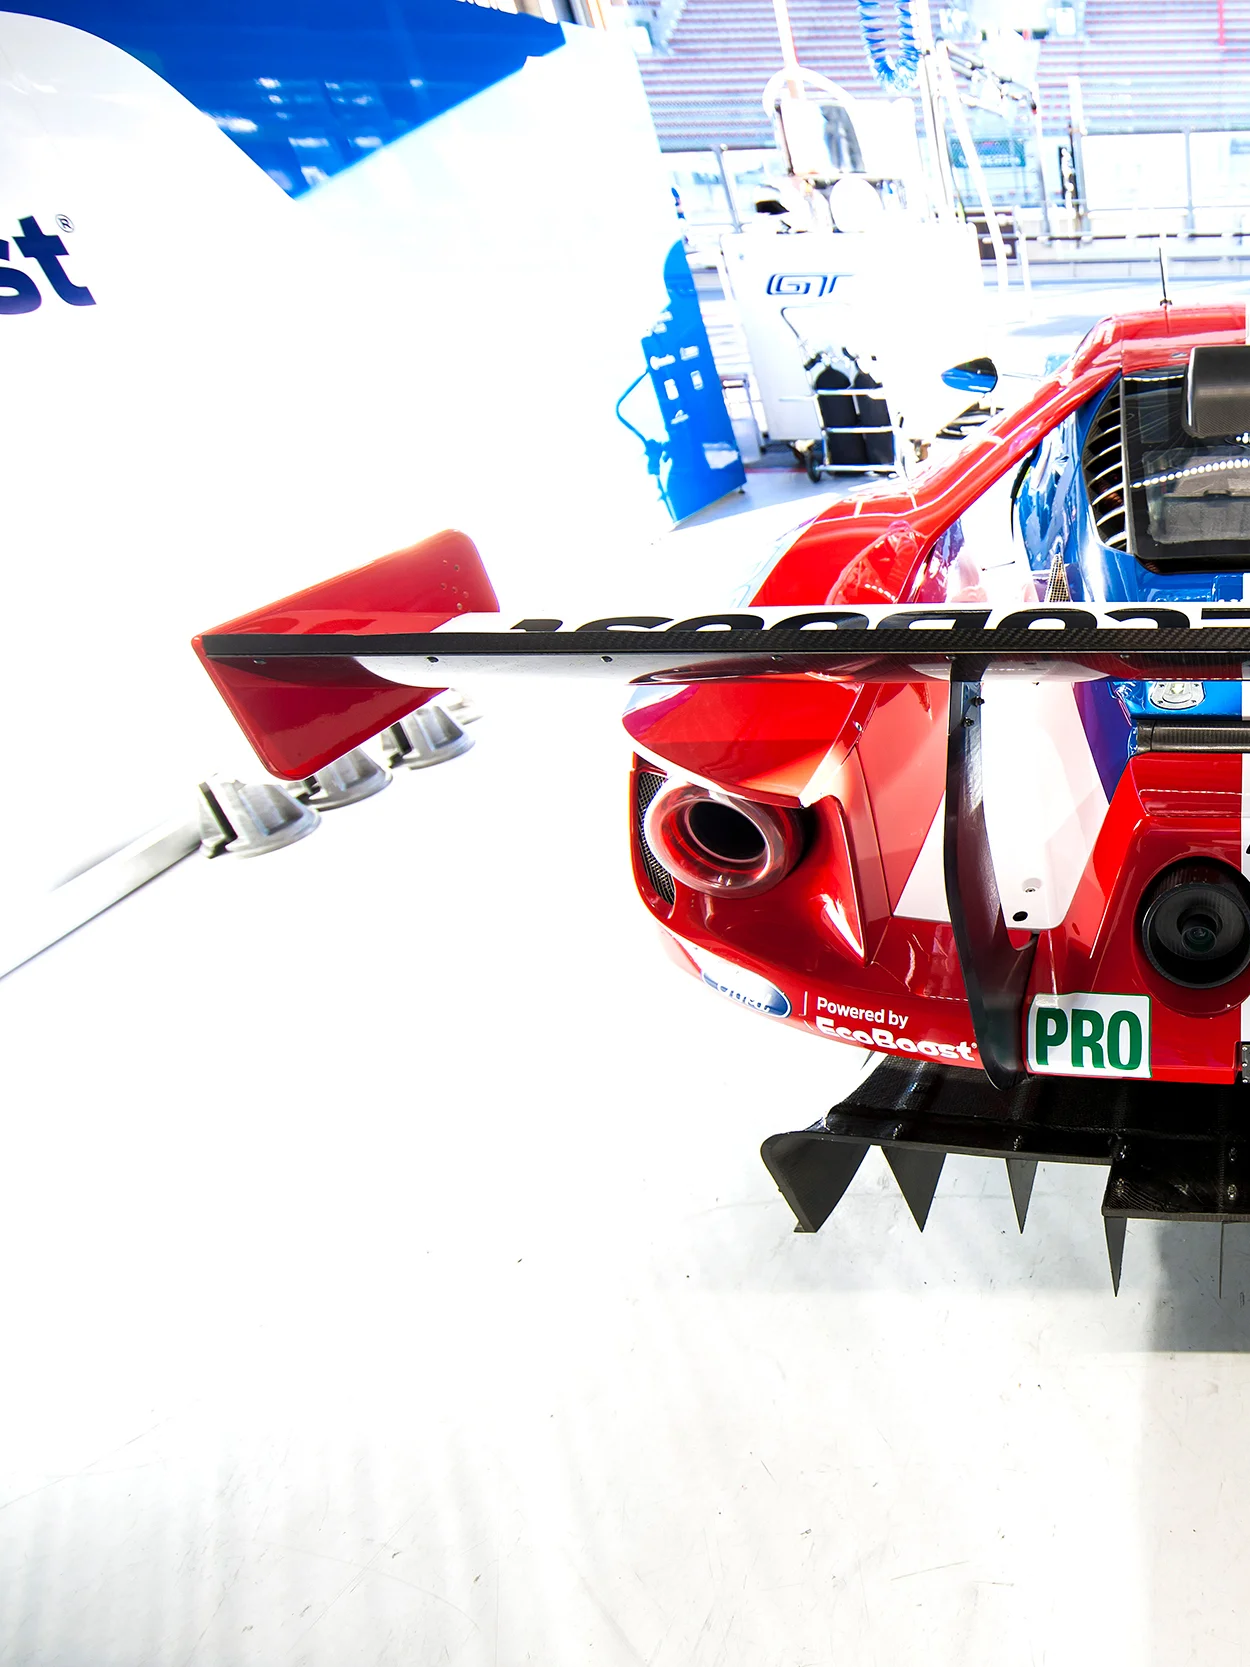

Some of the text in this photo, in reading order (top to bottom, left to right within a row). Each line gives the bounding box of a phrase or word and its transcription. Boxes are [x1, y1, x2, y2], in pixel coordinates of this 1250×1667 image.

[766, 272, 854, 297] GT
[817, 996, 909, 1029] Powered by
[1034, 1007, 1143, 1071] PRO
